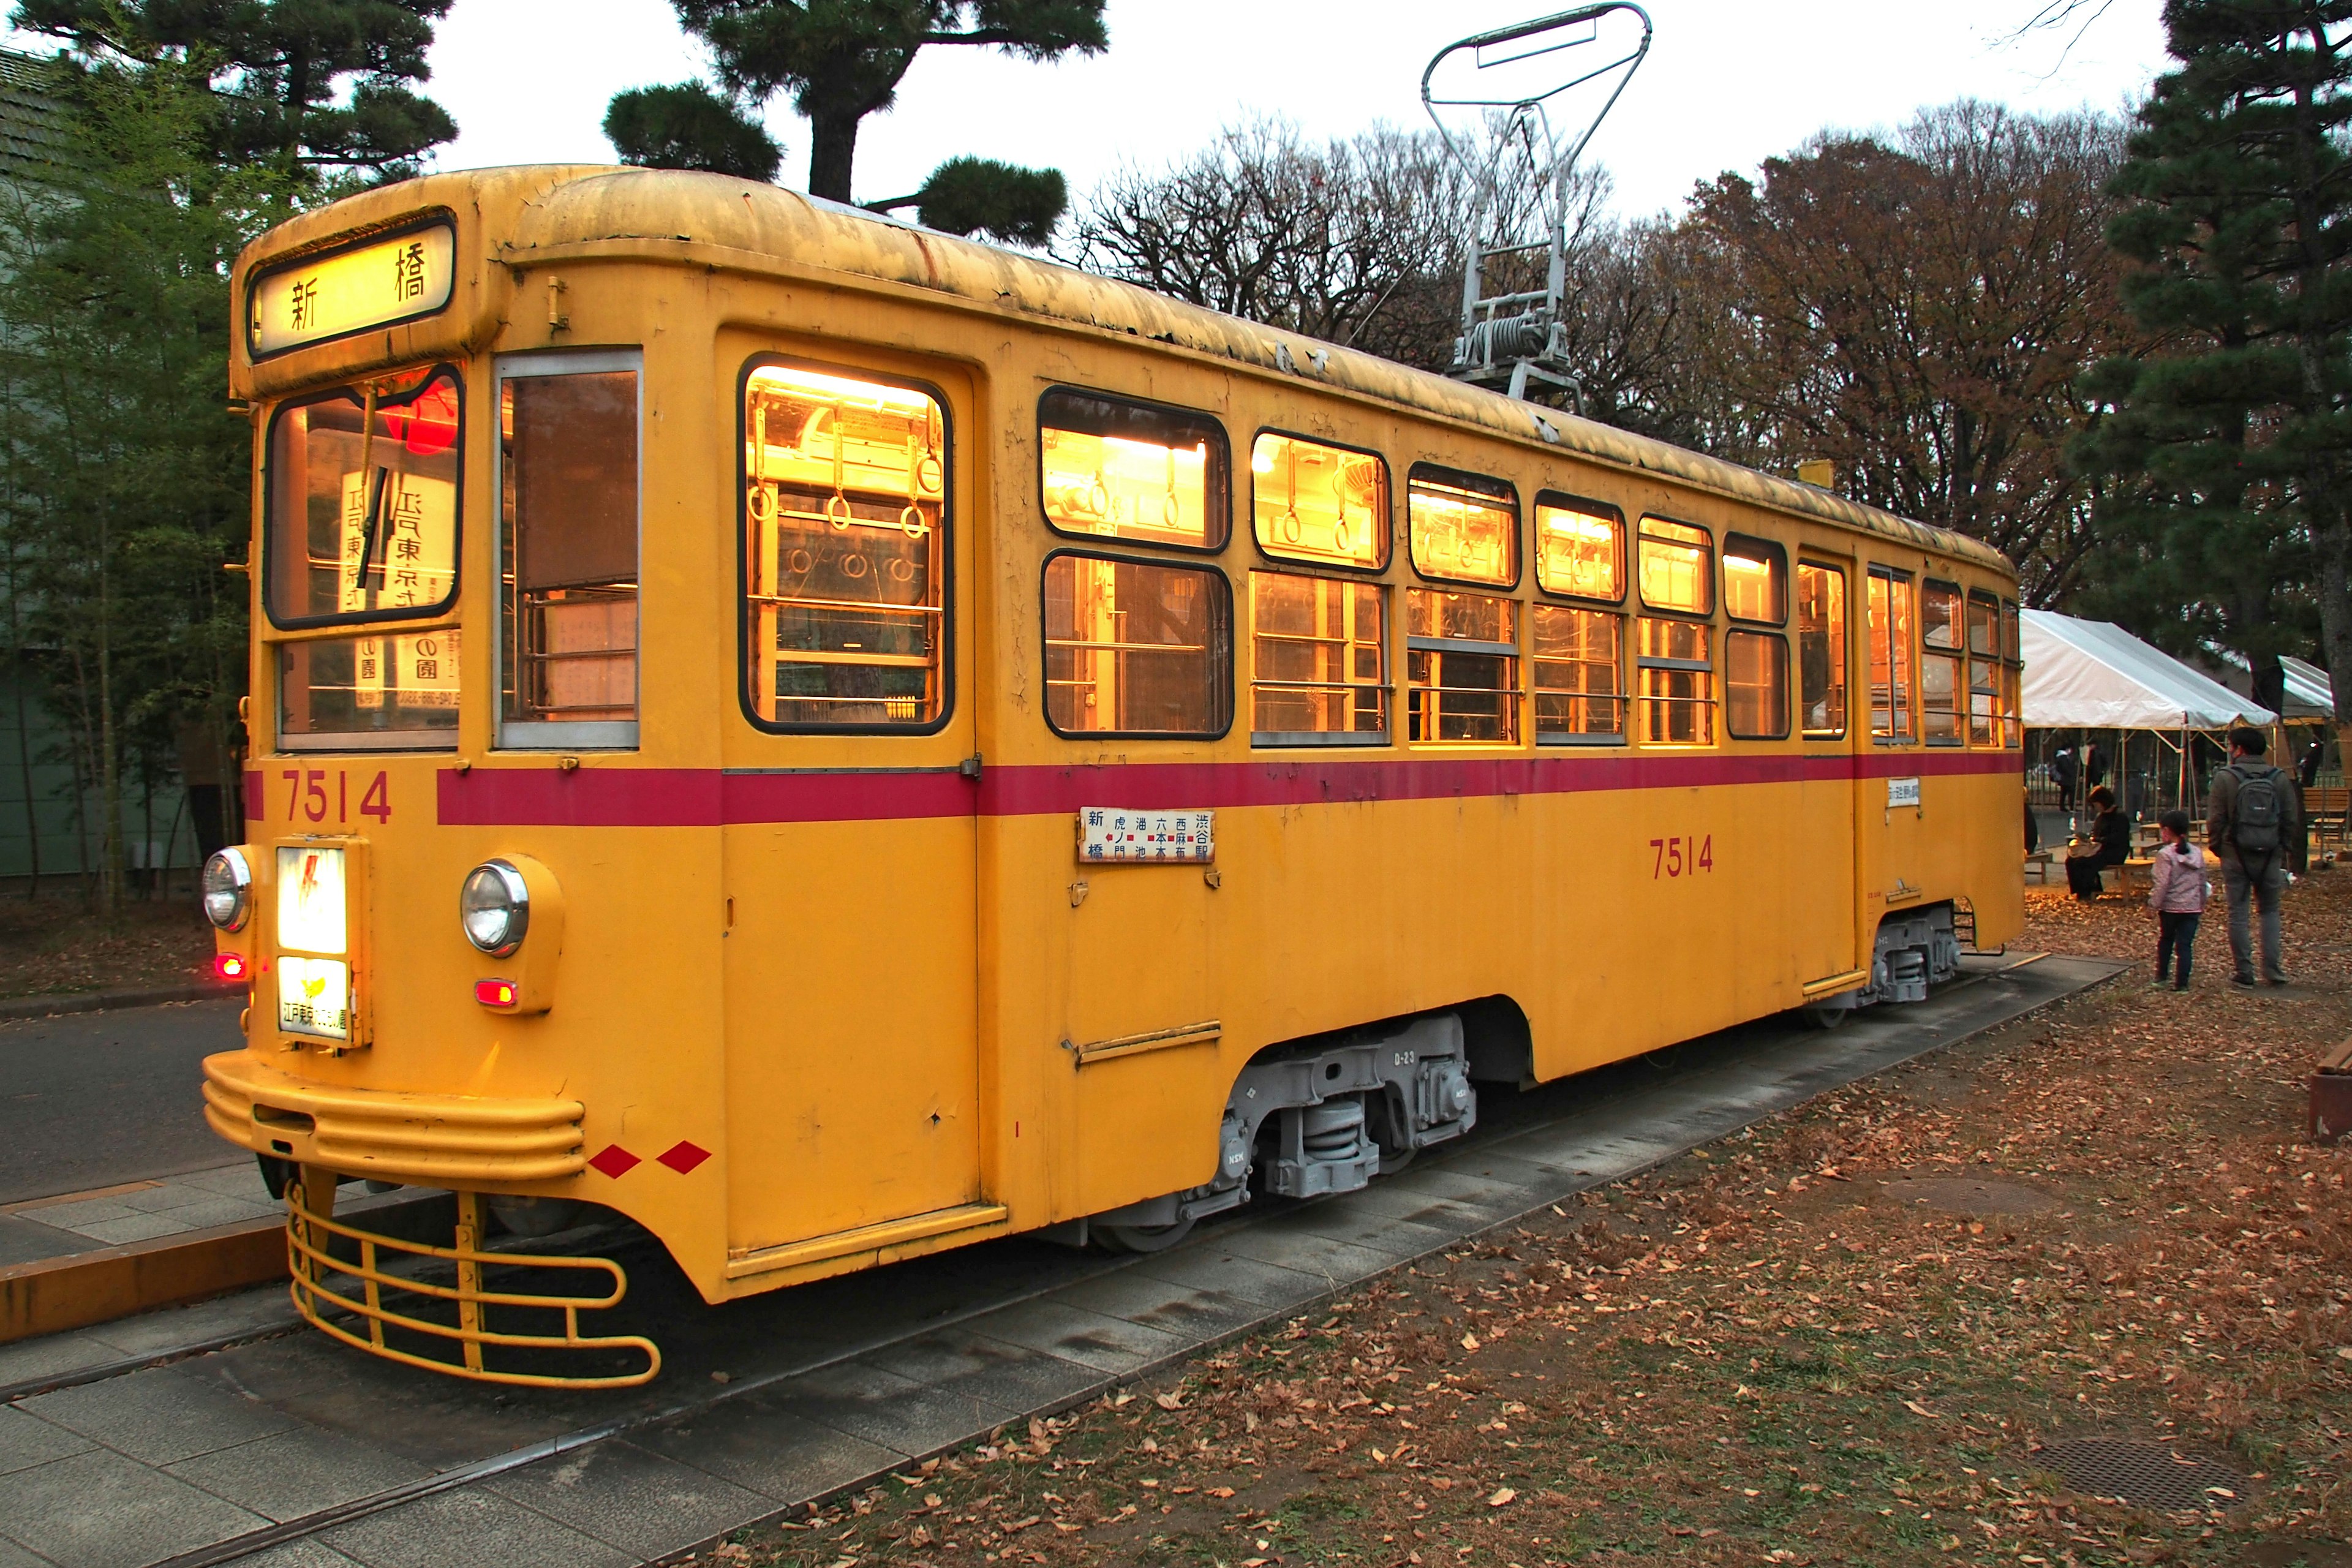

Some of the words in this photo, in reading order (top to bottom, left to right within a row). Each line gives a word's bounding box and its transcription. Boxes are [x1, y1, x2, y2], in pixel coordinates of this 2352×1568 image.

[292, 242, 424, 331] 新橋
[283, 769, 392, 824] 7514
[1088, 810, 1104, 860] 新橋
[1114, 816, 1126, 859] 虎ノ門
[1156, 818, 1167, 858] 六本木
[1175, 818, 1187, 858] 西麻布
[1195, 814, 1209, 861] 渋谷駅
[1649, 834, 1713, 880] 7514
[283, 1001, 347, 1030] 江戸東京園
[1393, 1050, 1415, 1066] D-23
[1228, 1151, 1245, 1165] NSK
